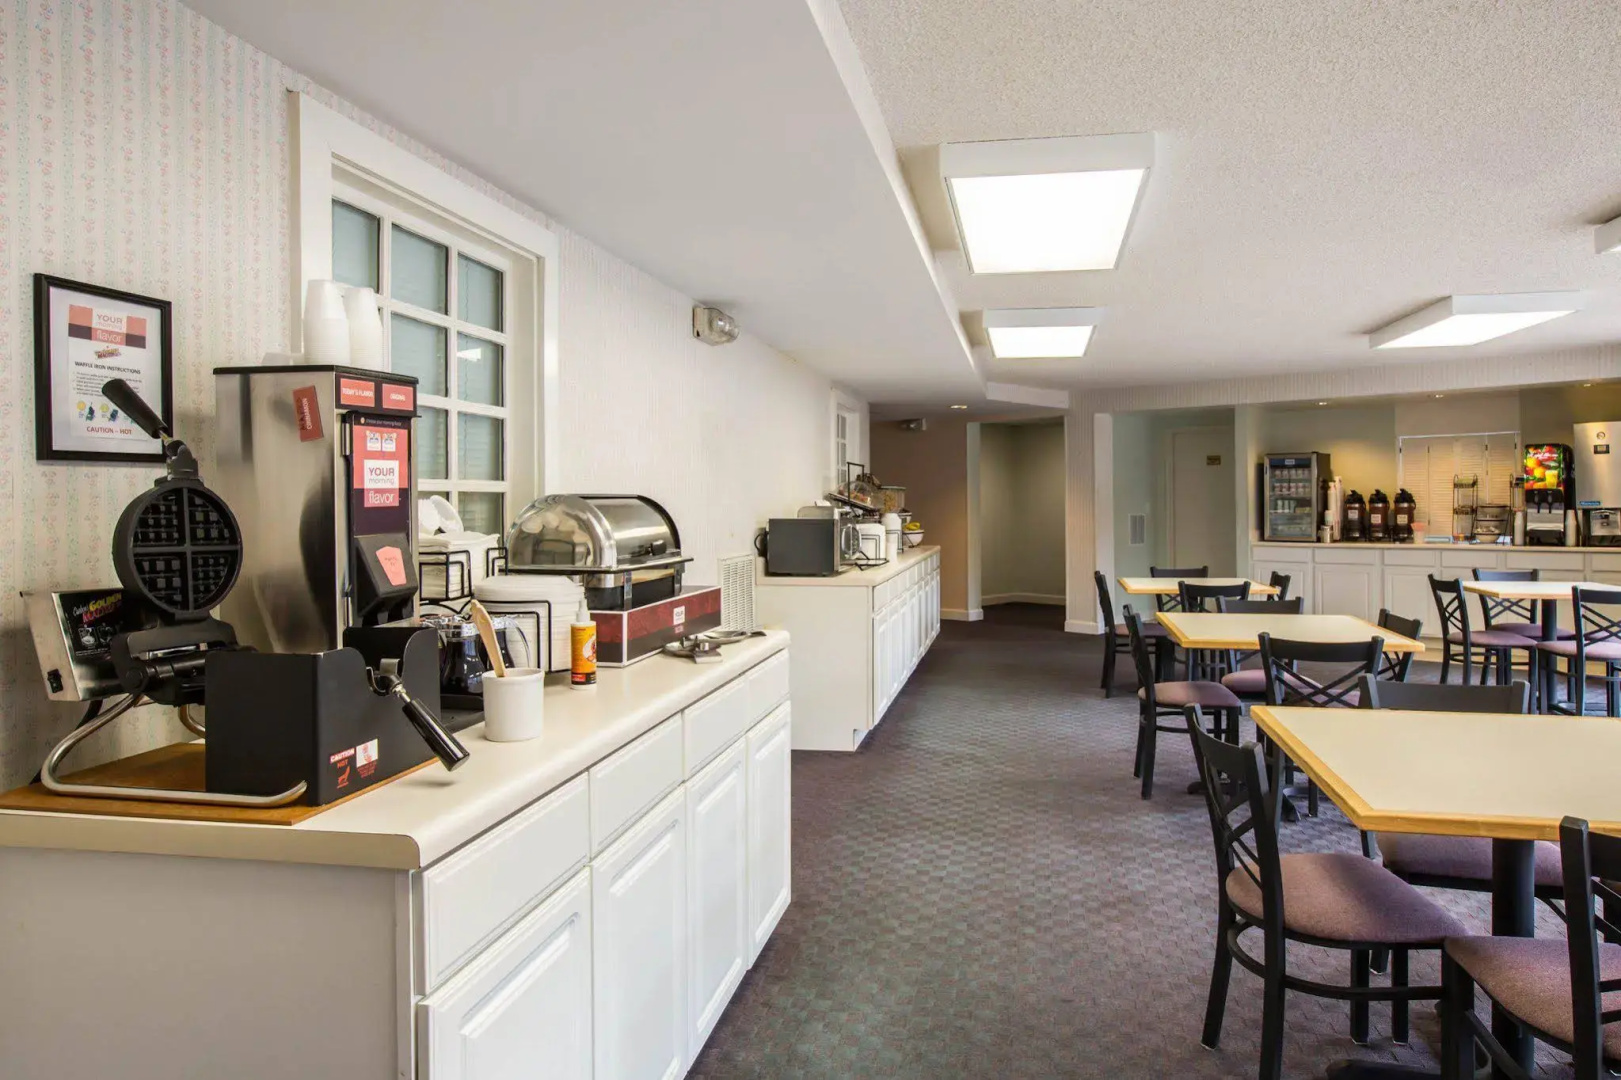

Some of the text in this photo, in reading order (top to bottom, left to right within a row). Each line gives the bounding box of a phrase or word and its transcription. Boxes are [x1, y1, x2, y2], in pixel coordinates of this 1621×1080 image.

[97, 314, 123, 324] YOUR
[97, 330, 122, 343] flavor
[107, 366, 141, 374] INSTRUCTIONS
[86, 426, 114, 434] CAUTION
[368, 467, 395, 477] YOUR
[368, 478, 394, 486] morning
[368, 490, 395, 504] flavor
[330, 748, 355, 763] CAUTION
[337, 759, 348, 768] HOT
